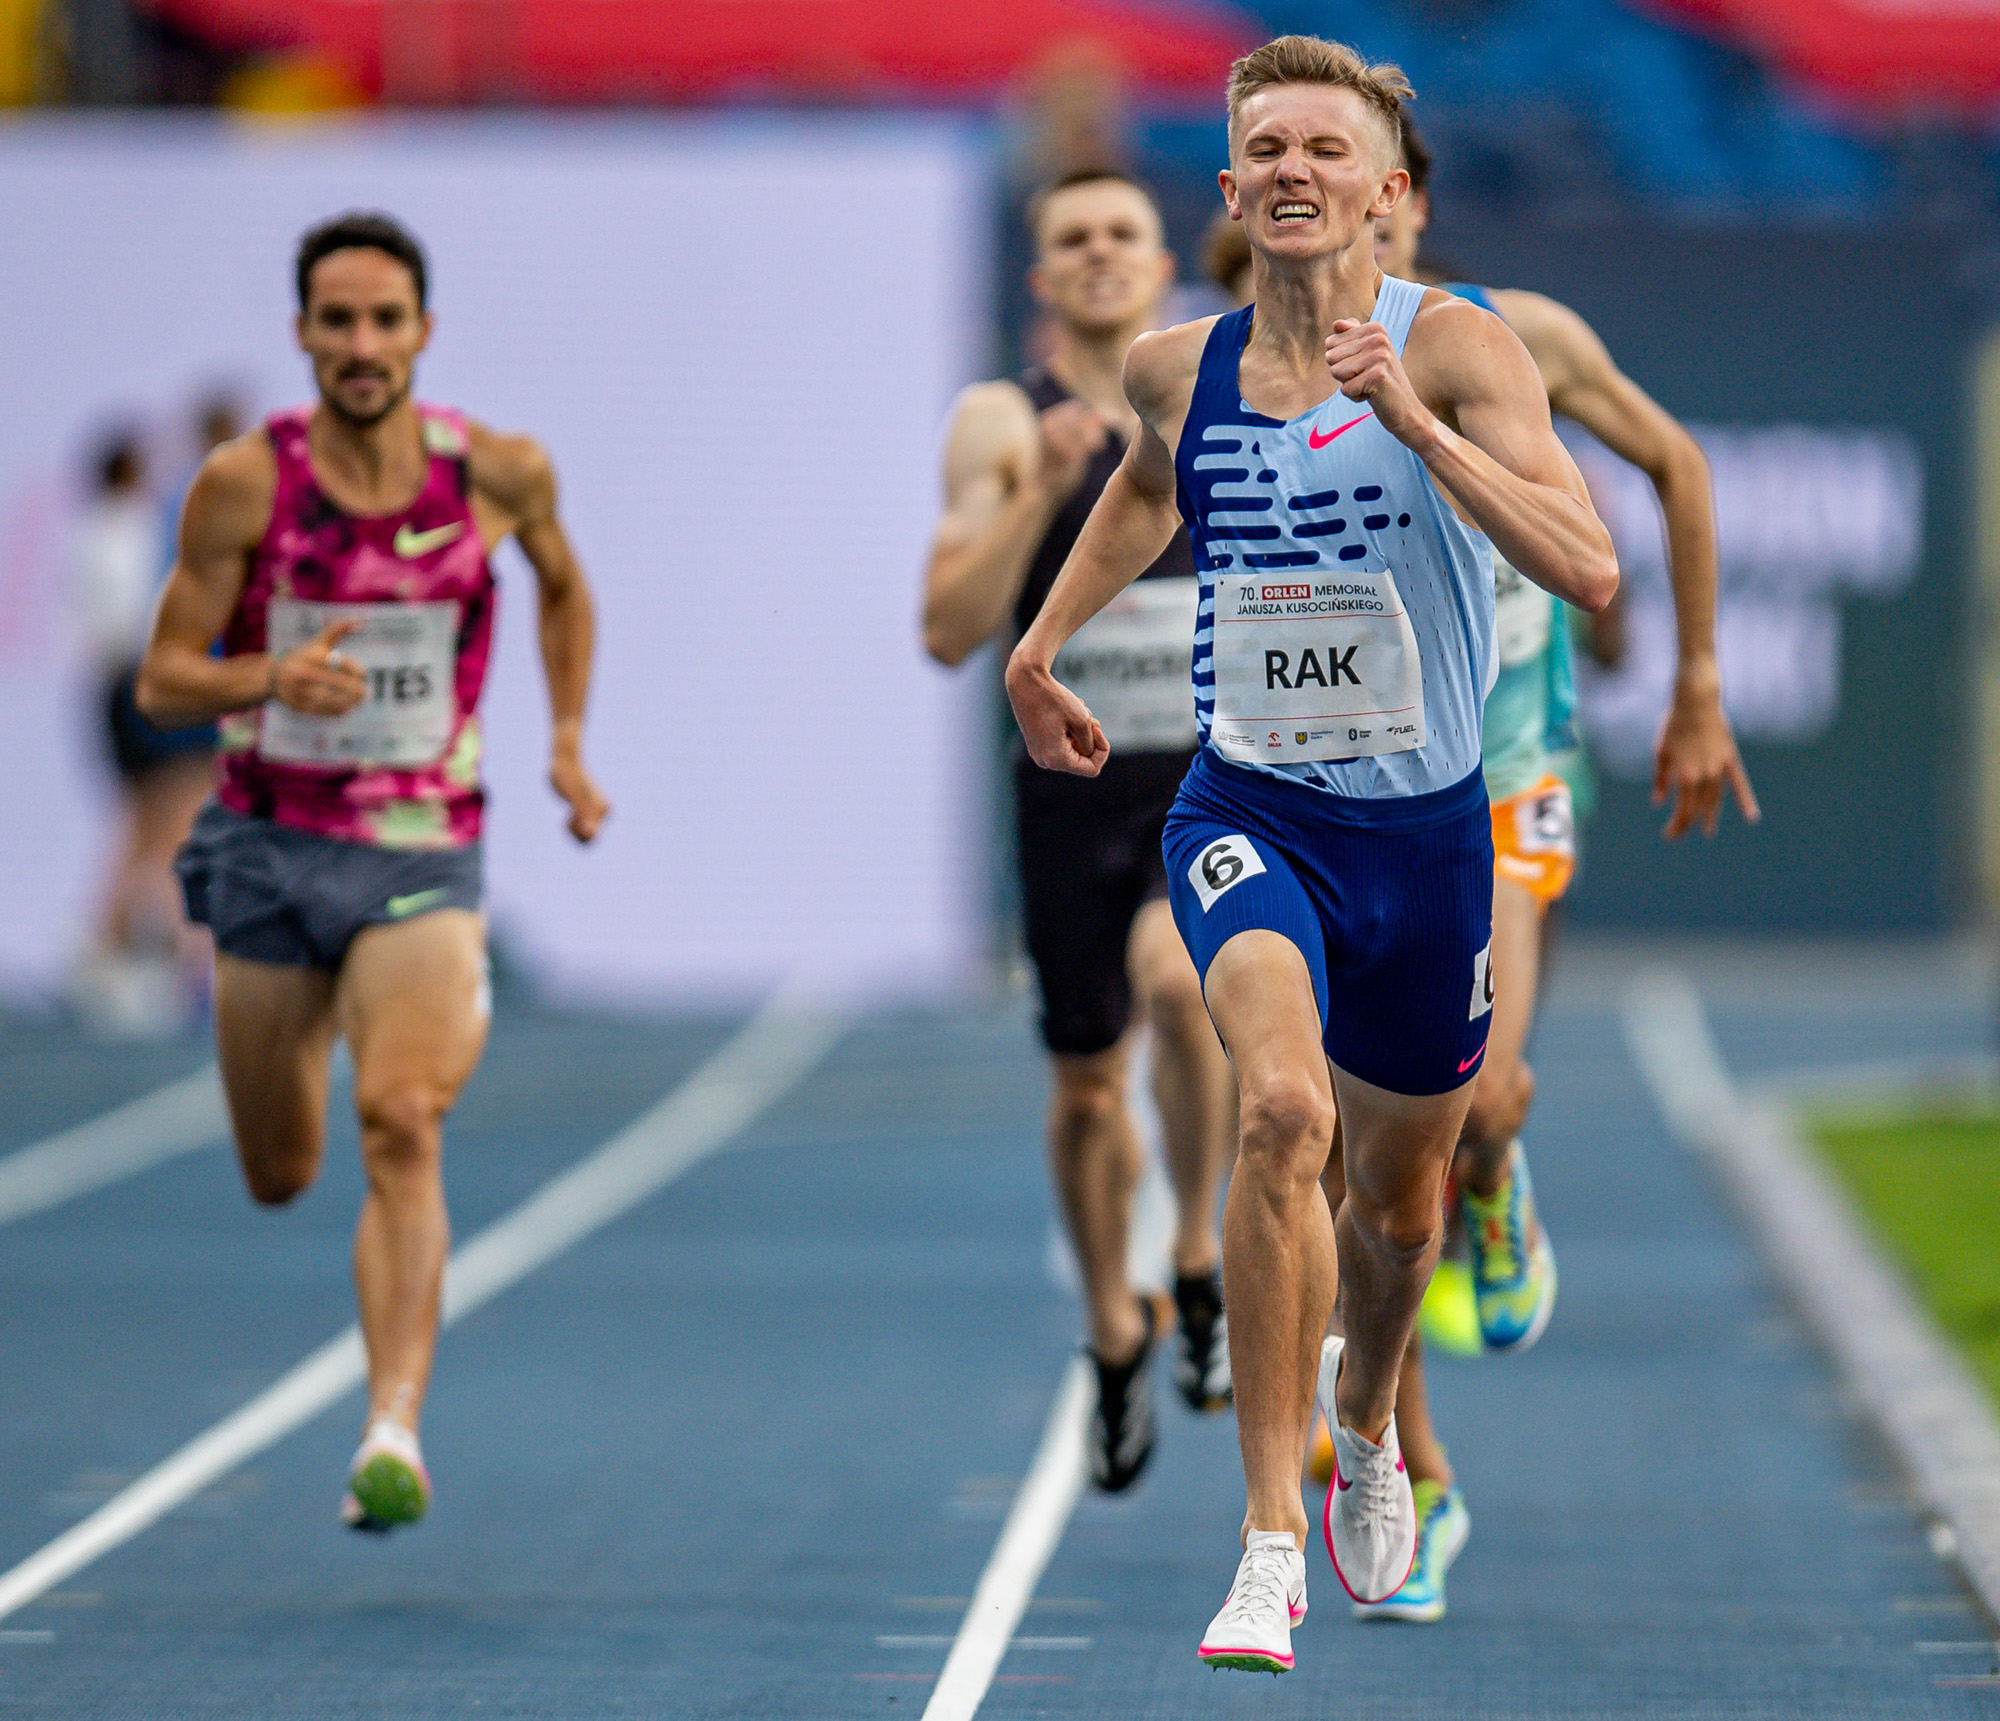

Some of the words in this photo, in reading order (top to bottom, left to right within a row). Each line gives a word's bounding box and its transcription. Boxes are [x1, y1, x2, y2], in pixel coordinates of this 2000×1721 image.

[1237, 602, 1283, 615] JANUSZA
[1286, 598, 1384, 614] KUSOCIŃSKIEGO
[1240, 586, 1259, 601] 70.
[1263, 585, 1308, 599] ORLEN
[1314, 584, 1378, 597] MEMORIAŁ
[1264, 644, 1362, 690] RAK
[1201, 843, 1244, 891] 6
